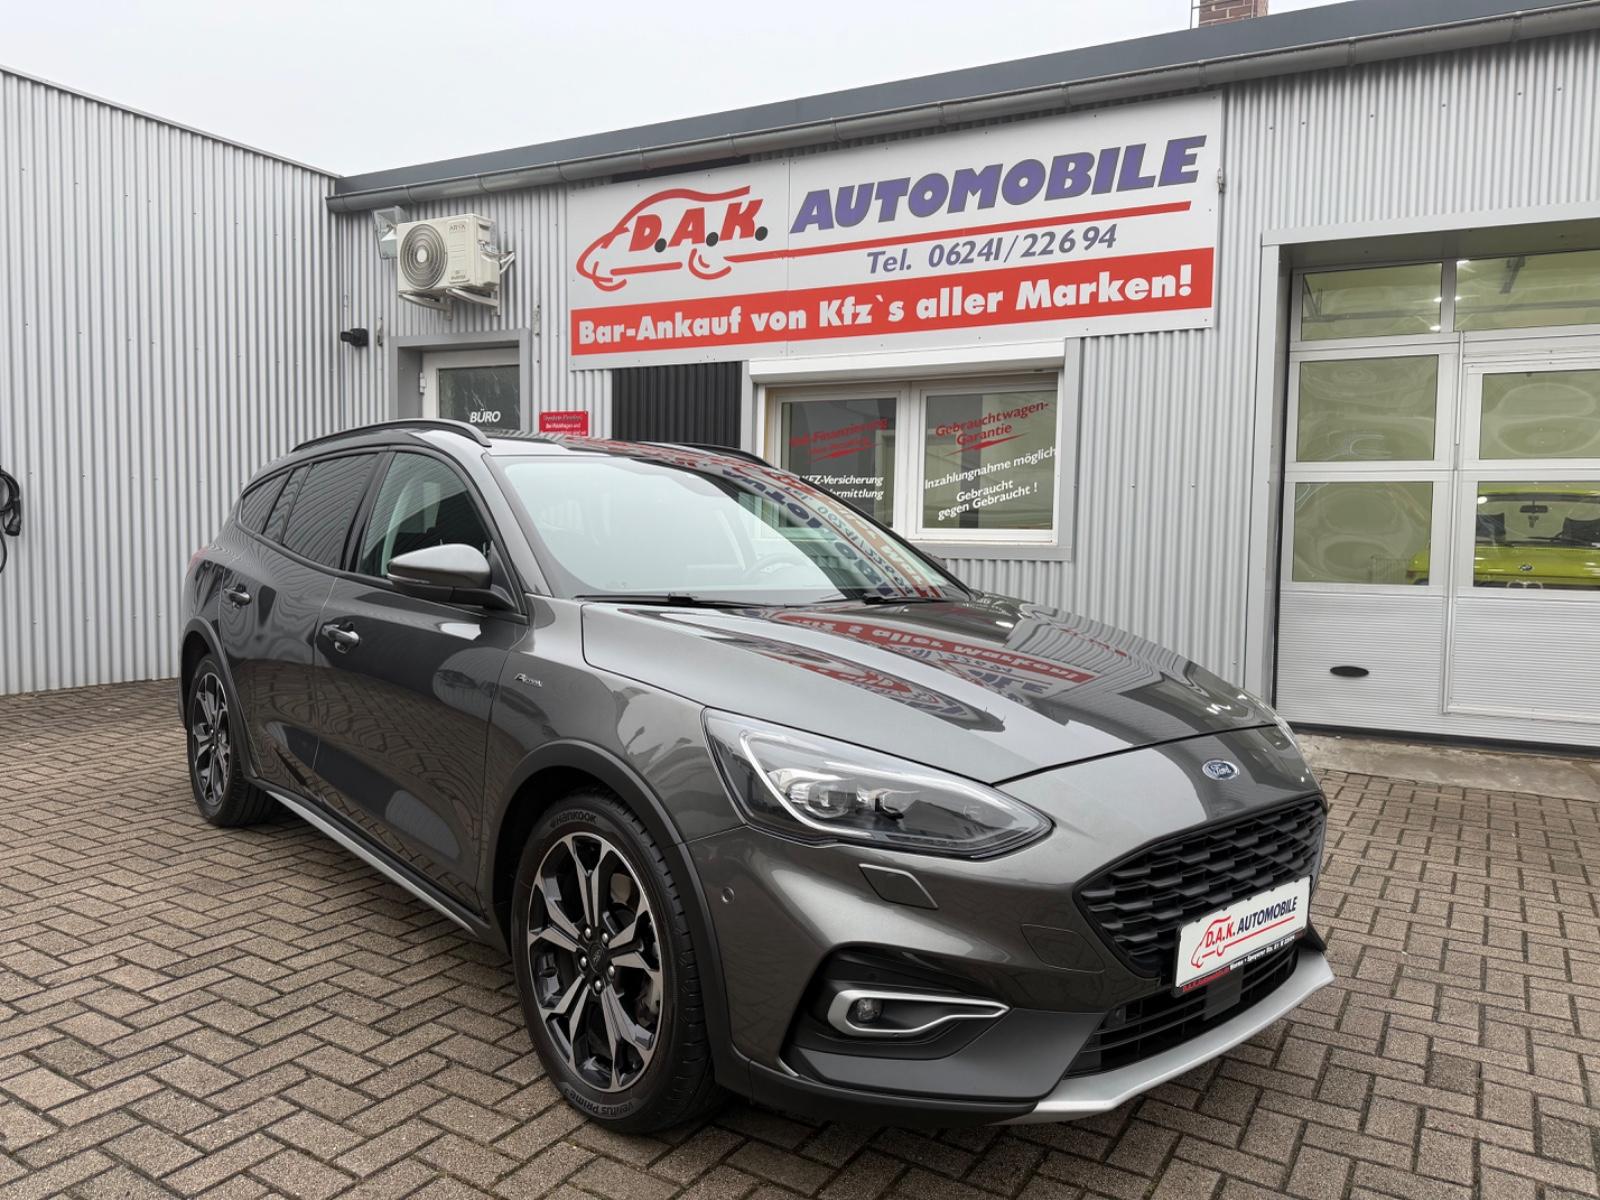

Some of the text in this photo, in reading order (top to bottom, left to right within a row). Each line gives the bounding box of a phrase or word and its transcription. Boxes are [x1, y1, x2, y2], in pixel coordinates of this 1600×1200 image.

[628, 134, 1207, 253] D.A.K. AUTOMOBILE
[867, 248, 912, 274] Tel.
[578, 305, 742, 345] Bar-Ankauf
[751, 309, 807, 332] von
[915, 286, 1004, 320] aller
[1015, 263, 1192, 311] Marken!
[469, 408, 501, 423] BÜRO
[935, 401, 1049, 438] Gebrauchtwagen-
[956, 423, 1013, 446] Garantie
[924, 460, 1011, 489] Inzahlungnahme
[956, 479, 1014, 502] Gebraucht
[938, 502, 969, 521] gegen
[972, 484, 1031, 509] Gebraucht
[1204, 922, 1236, 948] D.A.K.
[1236, 896, 1298, 935] AUTOMOBILE
